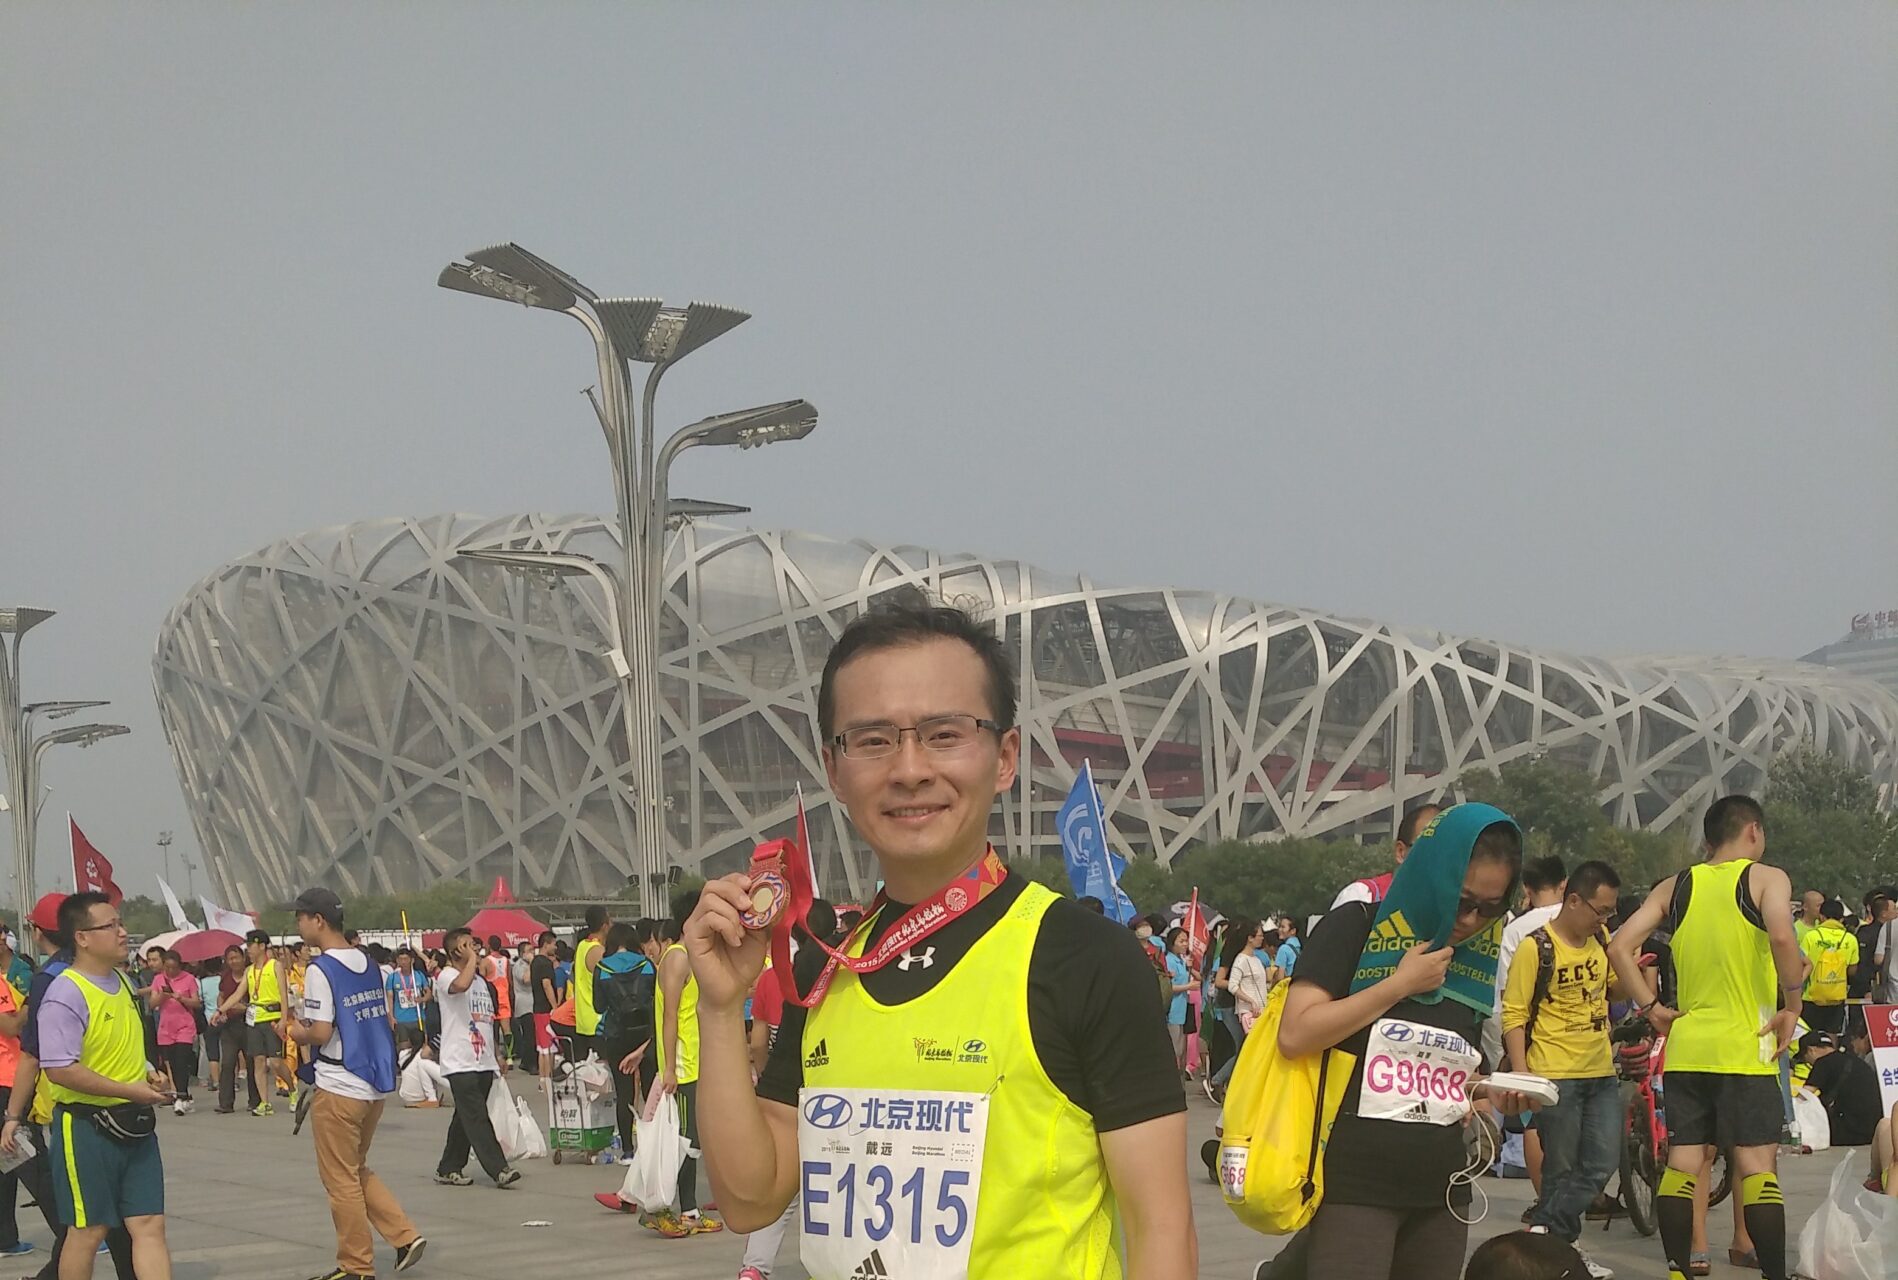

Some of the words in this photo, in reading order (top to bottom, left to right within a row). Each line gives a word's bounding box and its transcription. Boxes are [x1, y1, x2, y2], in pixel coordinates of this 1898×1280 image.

[854, 957, 878, 969] 2015
[805, 1056, 830, 1068] adidas
[957, 1054, 989, 1064] 北京现代
[1367, 1054, 1467, 1103] G9668
[860, 1097, 974, 1133] 北京现代
[1404, 1113, 1431, 1122] adidas
[802, 1161, 970, 1248] E1315
